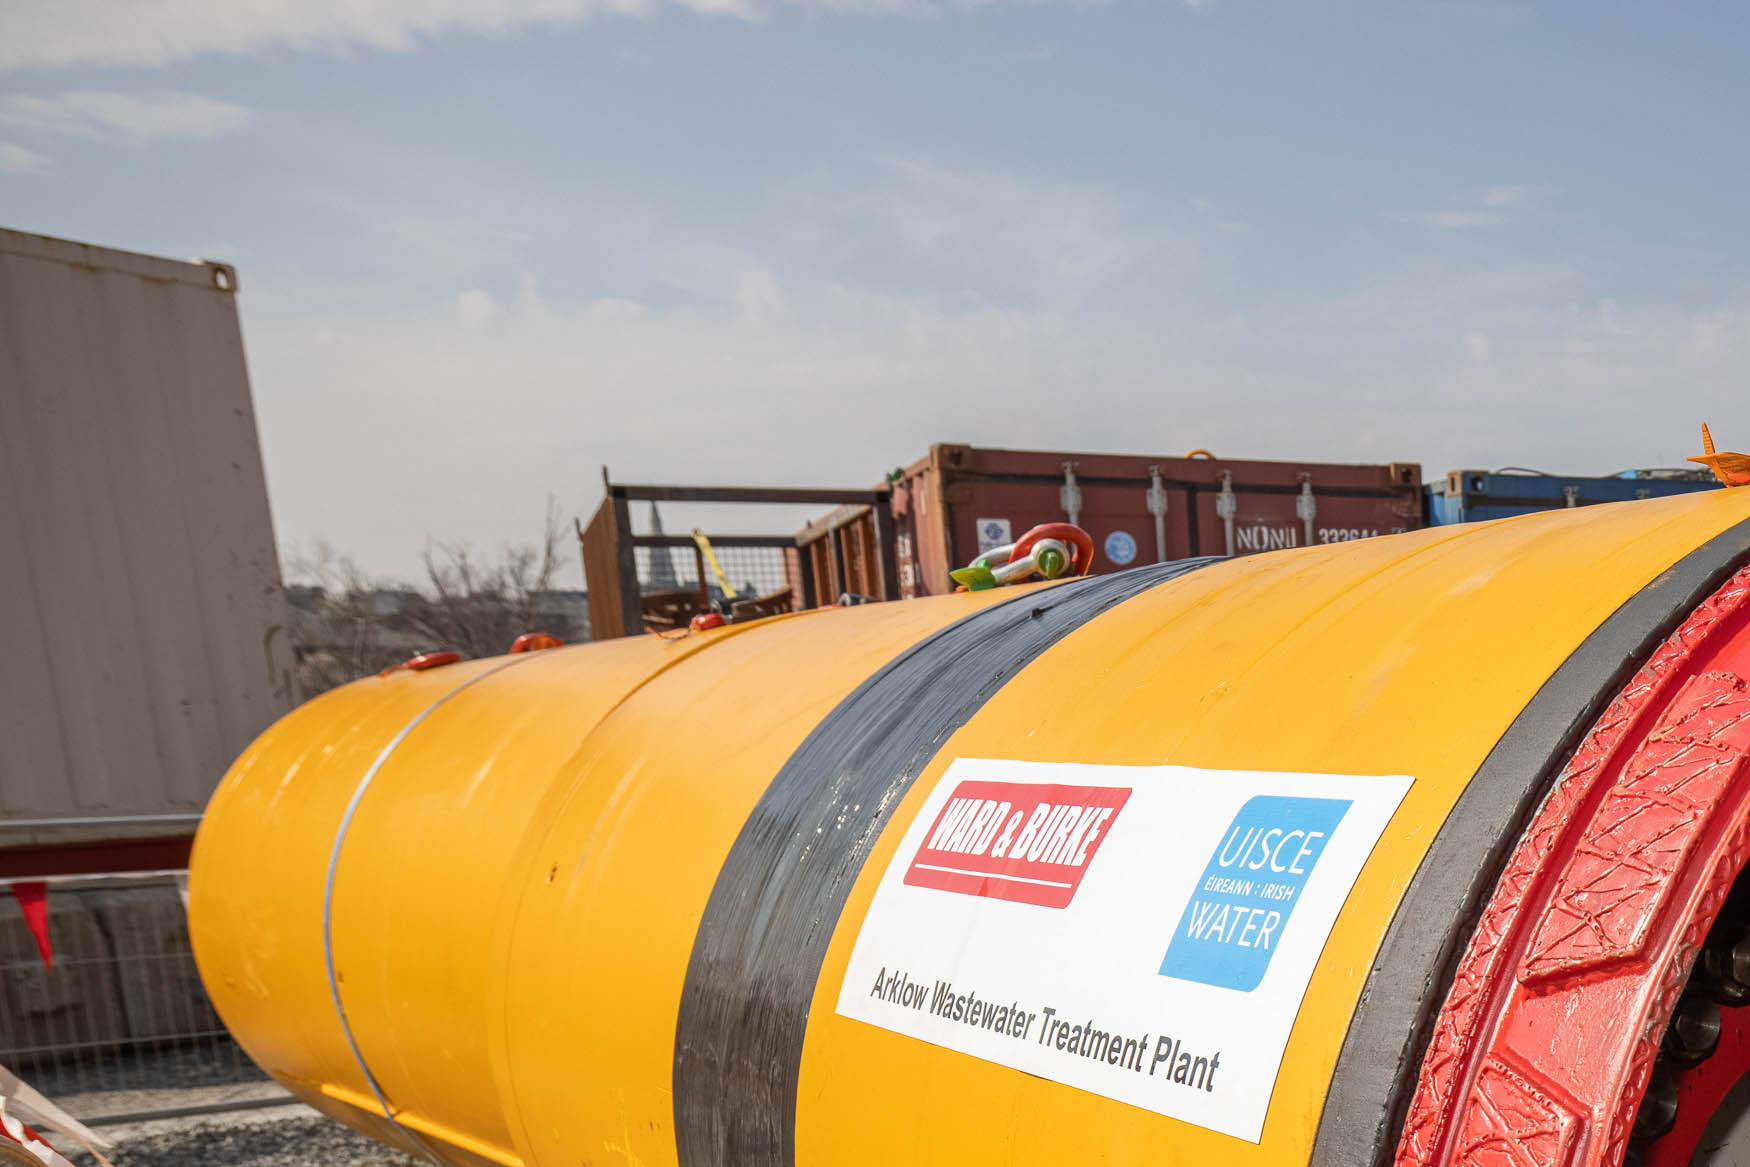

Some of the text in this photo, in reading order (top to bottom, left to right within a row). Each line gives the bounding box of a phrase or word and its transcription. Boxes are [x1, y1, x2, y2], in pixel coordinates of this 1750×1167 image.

[927, 798, 1114, 867] WARD & BURKE
[1218, 826, 1324, 875] UISCE
[1204, 874, 1254, 896] ÉIREANN
[1261, 883, 1295, 901] IRISH
[1187, 900, 1281, 950] WATER
[870, 967, 1220, 1092] Arklow Wastewater Treatment Plant
